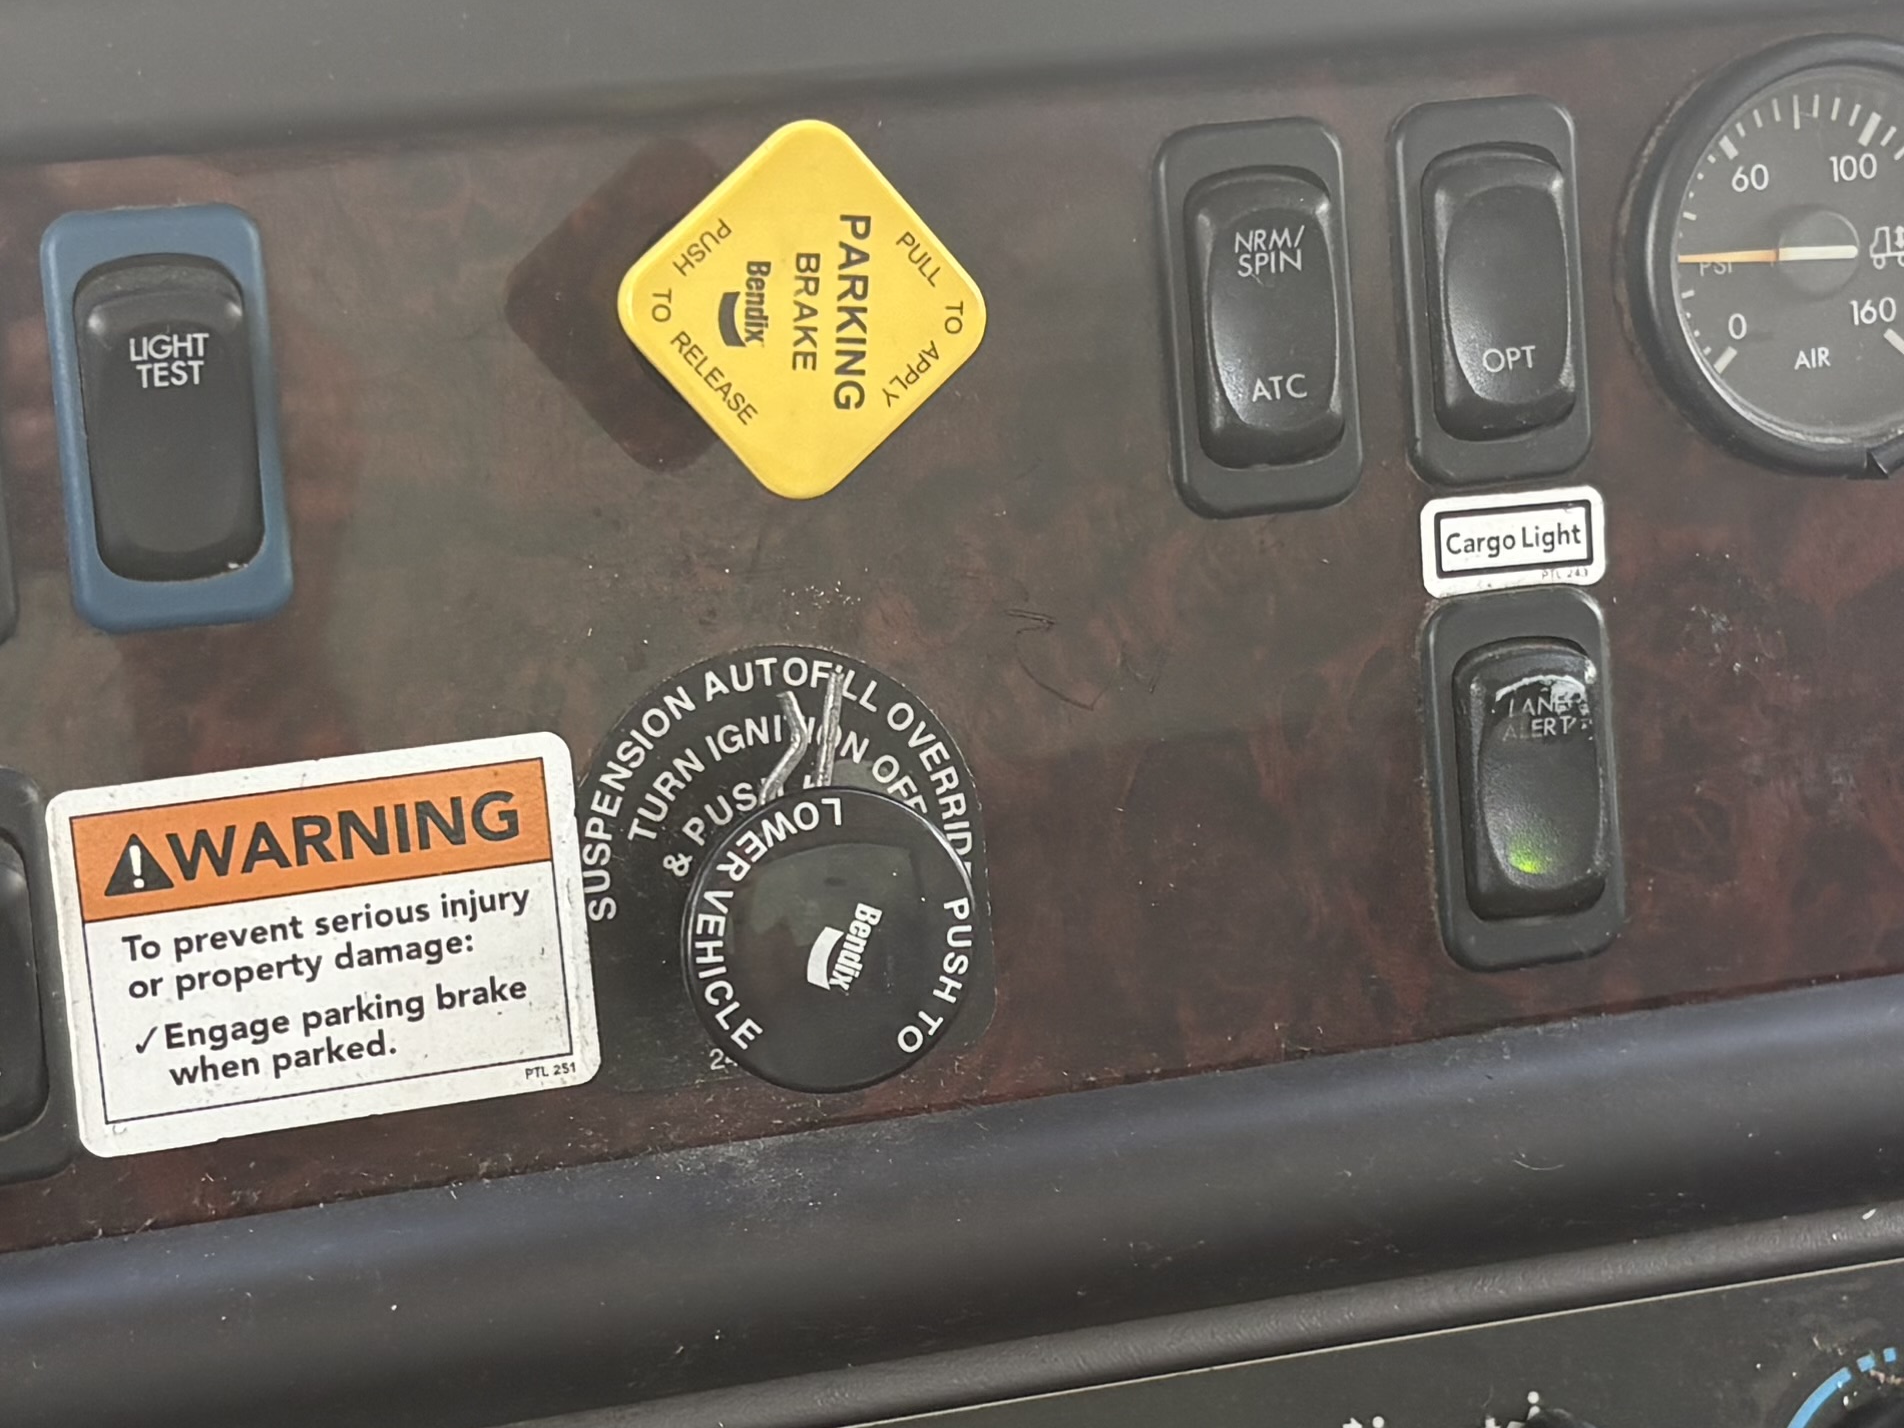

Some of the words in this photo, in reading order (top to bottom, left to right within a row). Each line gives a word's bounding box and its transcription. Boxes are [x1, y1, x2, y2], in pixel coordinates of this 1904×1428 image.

[1731, 163, 1769, 192] 60
[1830, 153, 1877, 182] 100
[672, 219, 732, 276] PUSH
[896, 231, 941, 288] PULL
[1234, 224, 1305, 254] NRM/
[1237, 249, 1302, 278] SPIN
[651, 288, 672, 323] TO
[744, 261, 772, 345] Bendix
[792, 252, 821, 372] BRAKE
[834, 214, 871, 410] PARKING
[944, 301, 964, 335] TO
[1728, 313, 1748, 340] 0
[1850, 297, 1897, 326] 160
[129, 332, 209, 362] LIGHT
[136, 360, 205, 389] TEST
[883, 341, 940, 408] APPLY
[1482, 345, 1536, 373] OPT
[1795, 347, 1831, 370] AIR
[670, 331, 758, 425] RELEASE
[1251, 374, 1308, 402] ATC
[1446, 531, 1517, 557] Cargo
[1521, 523, 1583, 557] Light
[582, 686, 696, 921] SUSPENSION
[704, 657, 878, 713] AUTOFLL
[886, 702, 973, 878] OVERRID
[628, 748, 705, 843] TURN
[166, 791, 521, 882] WARNING
[663, 852, 693, 877] &
[716, 797, 843, 882] LOWER
[121, 934, 161, 963] To
[174, 917, 304, 962] prevent
[315, 901, 430, 938] serious
[441, 887, 531, 924] injury
[829, 902, 883, 992] Bendix
[933, 897, 973, 1004] PUSH
[128, 976, 164, 999] or
[176, 953, 323, 1000] property
[335, 933, 475, 976] damage:
[696, 890, 763, 1050] VEHICLE
[165, 1014, 291, 1052] Engage
[302, 990, 426, 1034] parking
[436, 975, 528, 1012] brake
[898, 1009, 944, 1053] TO
[168, 1054, 260, 1087] when
[272, 1030, 398, 1078] parked.
[525, 1066, 549, 1081] PTL
[552, 1062, 578, 1077] 251
